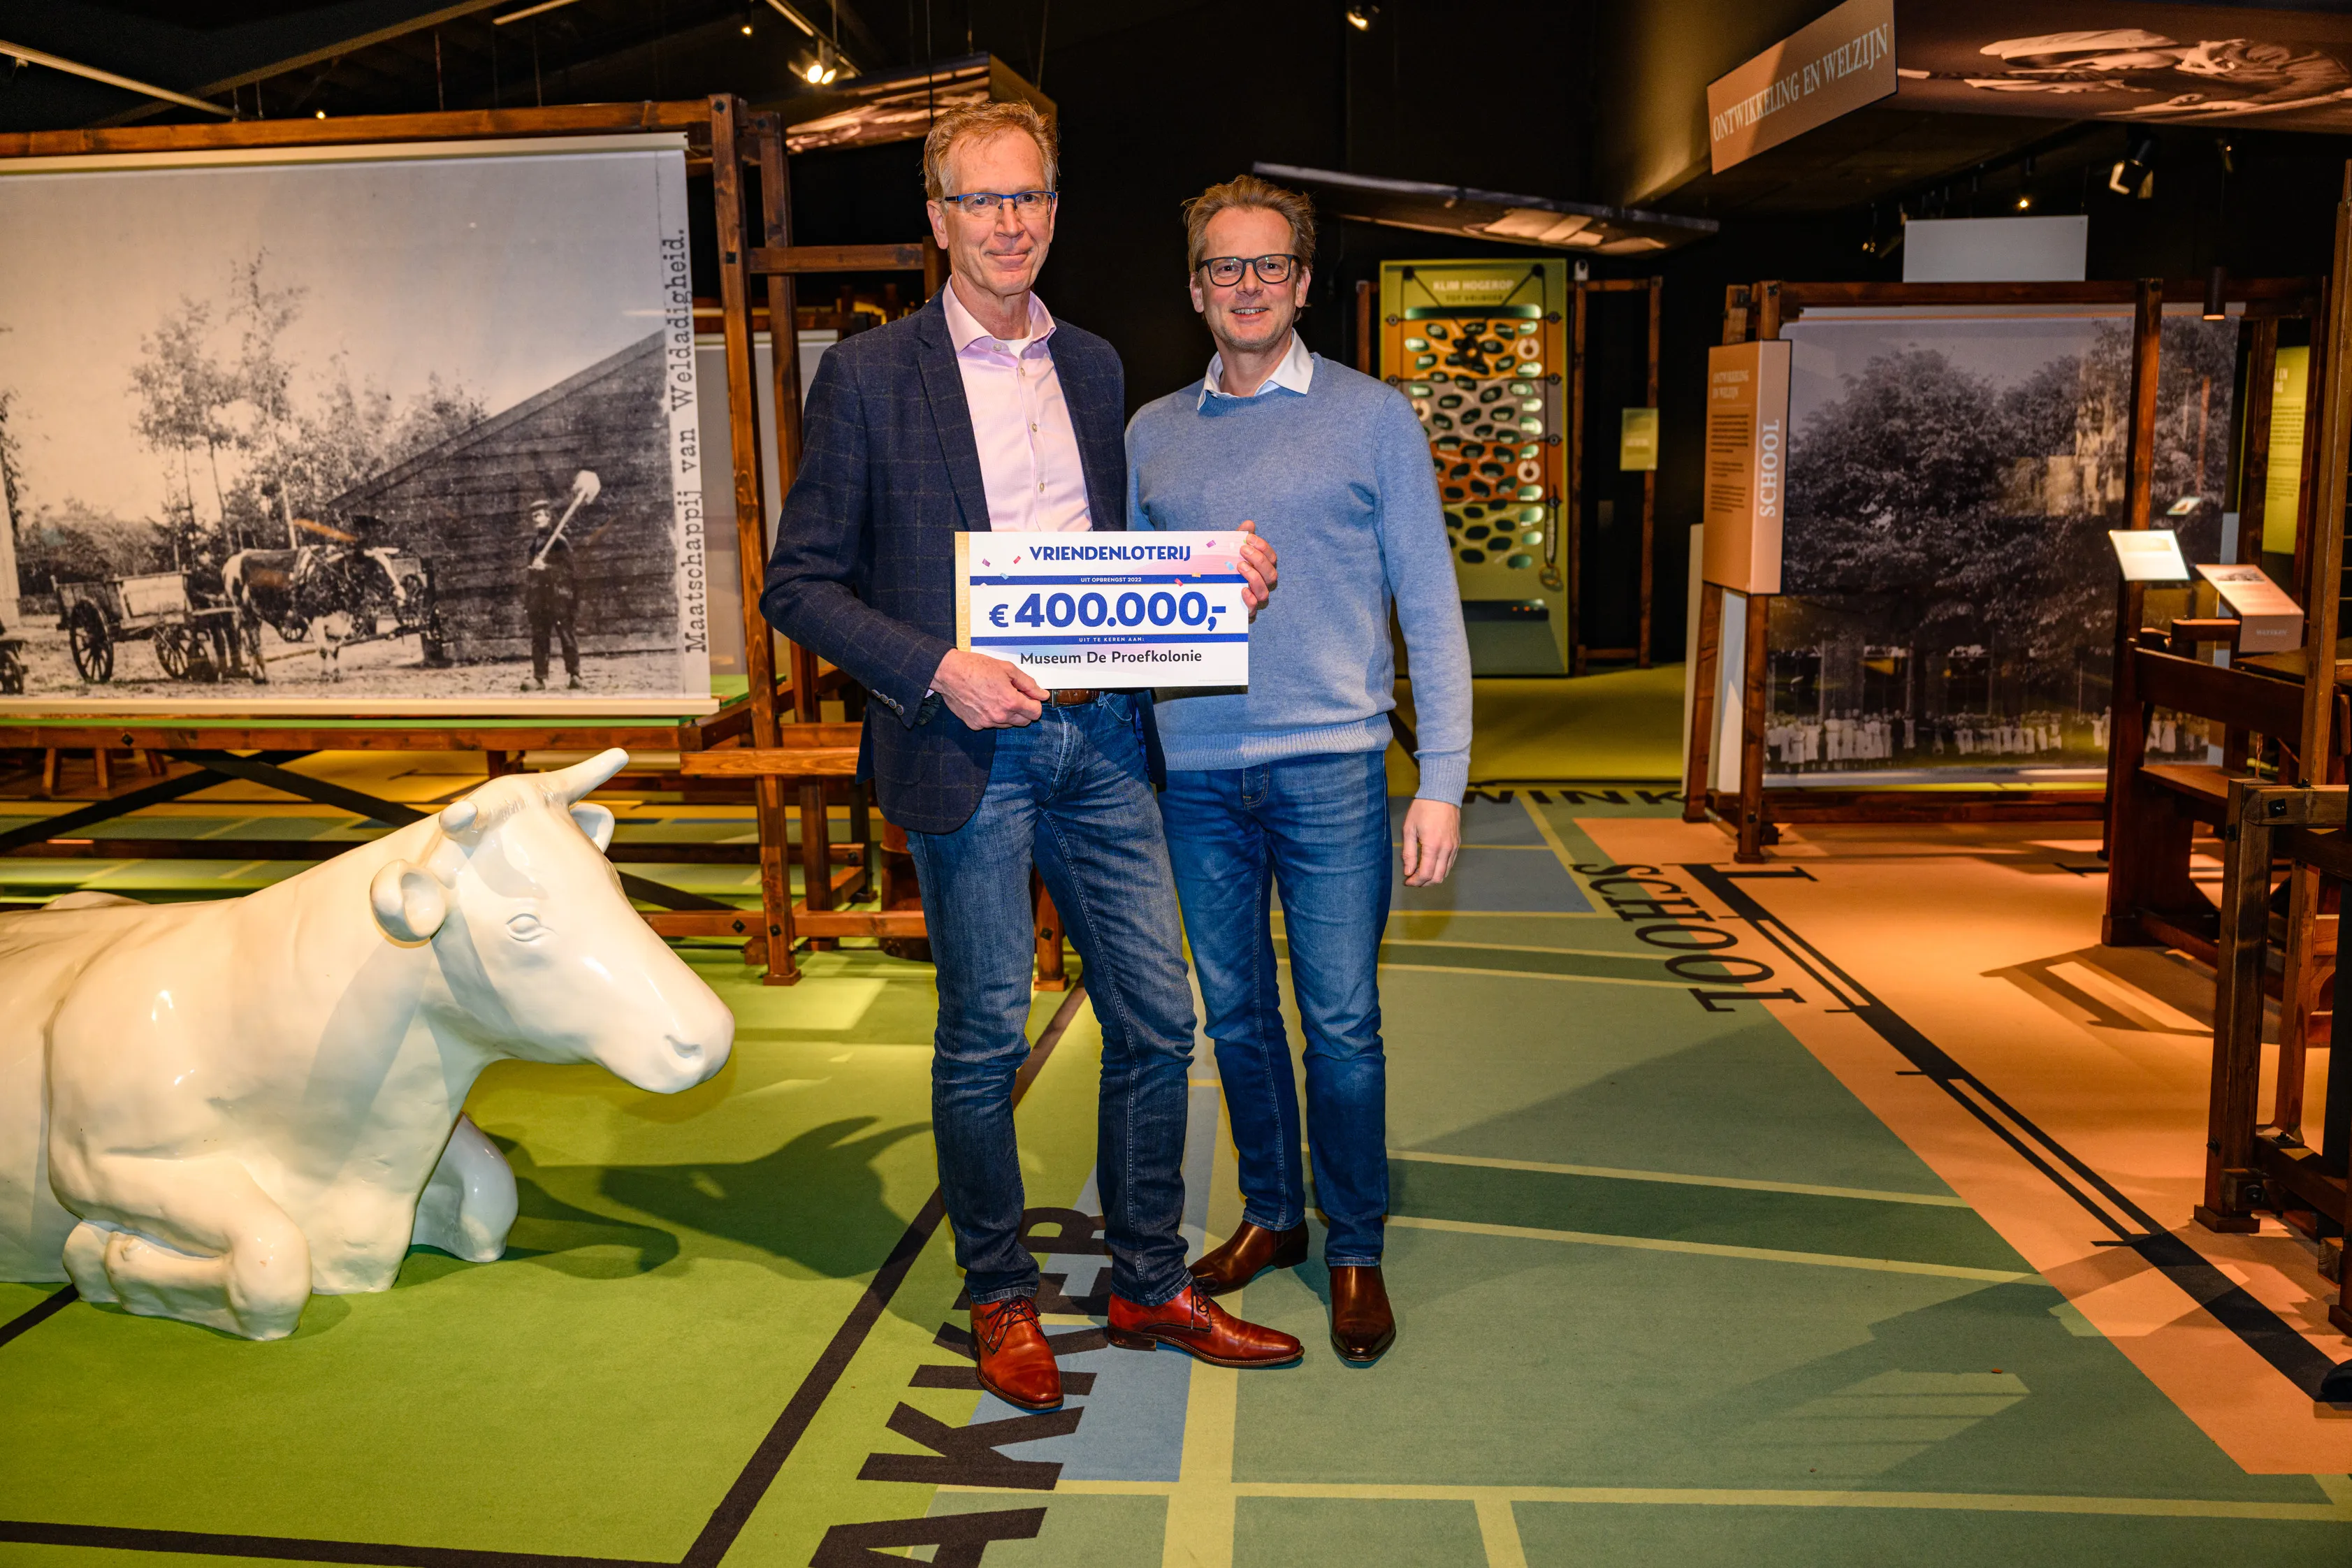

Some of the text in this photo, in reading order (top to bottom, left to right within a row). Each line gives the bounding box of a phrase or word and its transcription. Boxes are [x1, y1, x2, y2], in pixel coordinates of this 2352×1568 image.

[1713, 23, 1887, 142] ONTWIKKELING EN WELZIJN
[1433, 280, 1460, 291] KLIM
[662, 229, 706, 653] Maatschappij van Weldadigheid.
[1759, 419, 1779, 517] SCHOOL
[1029, 546, 1191, 561] VRIENDENLOTERIJ
[1020, 649, 1202, 664] Museum De Proefkolonie
[1569, 864, 1807, 1012] SCHOOL
